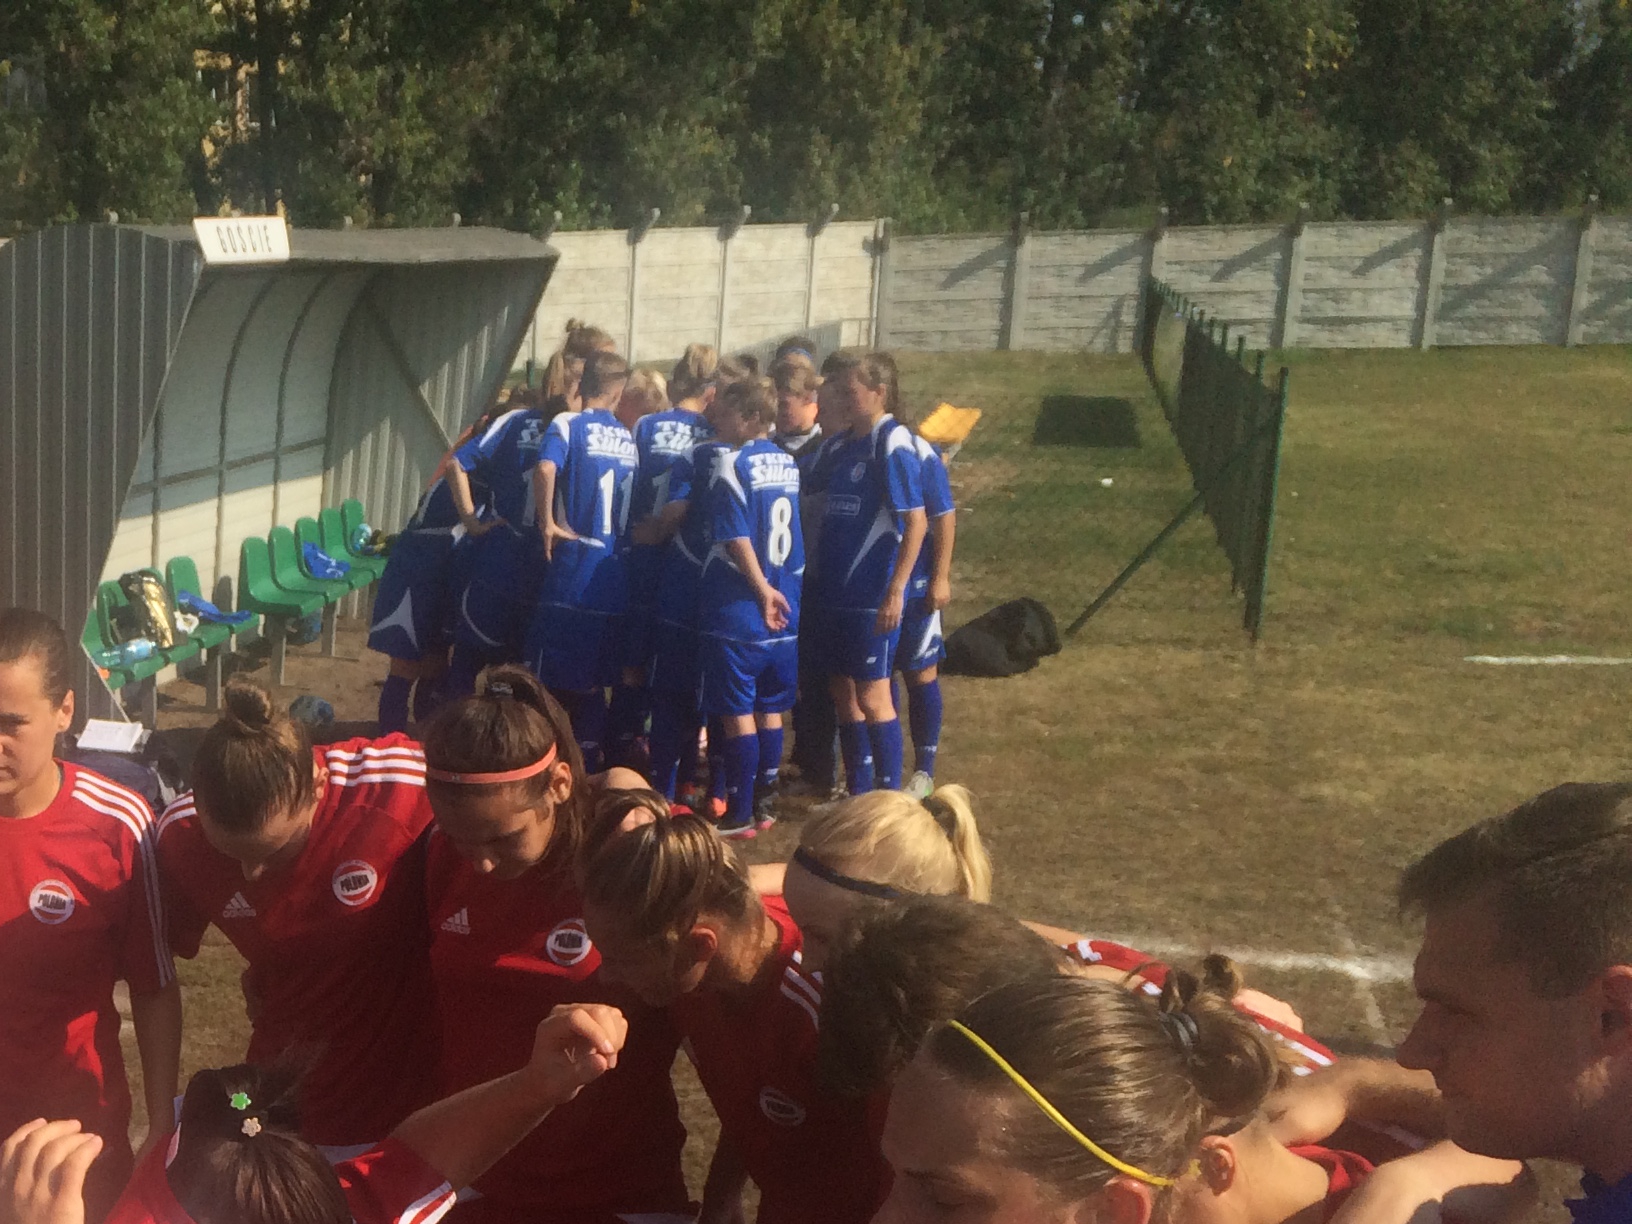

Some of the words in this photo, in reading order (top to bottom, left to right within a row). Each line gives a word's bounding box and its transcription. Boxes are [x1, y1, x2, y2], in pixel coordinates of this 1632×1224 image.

[769, 497, 792, 567] 8
[338, 873, 370, 892] POLONIA
[37, 892, 68, 911] POLONIA
[222, 906, 257, 918] adidas
[440, 920, 471, 936] adidas
